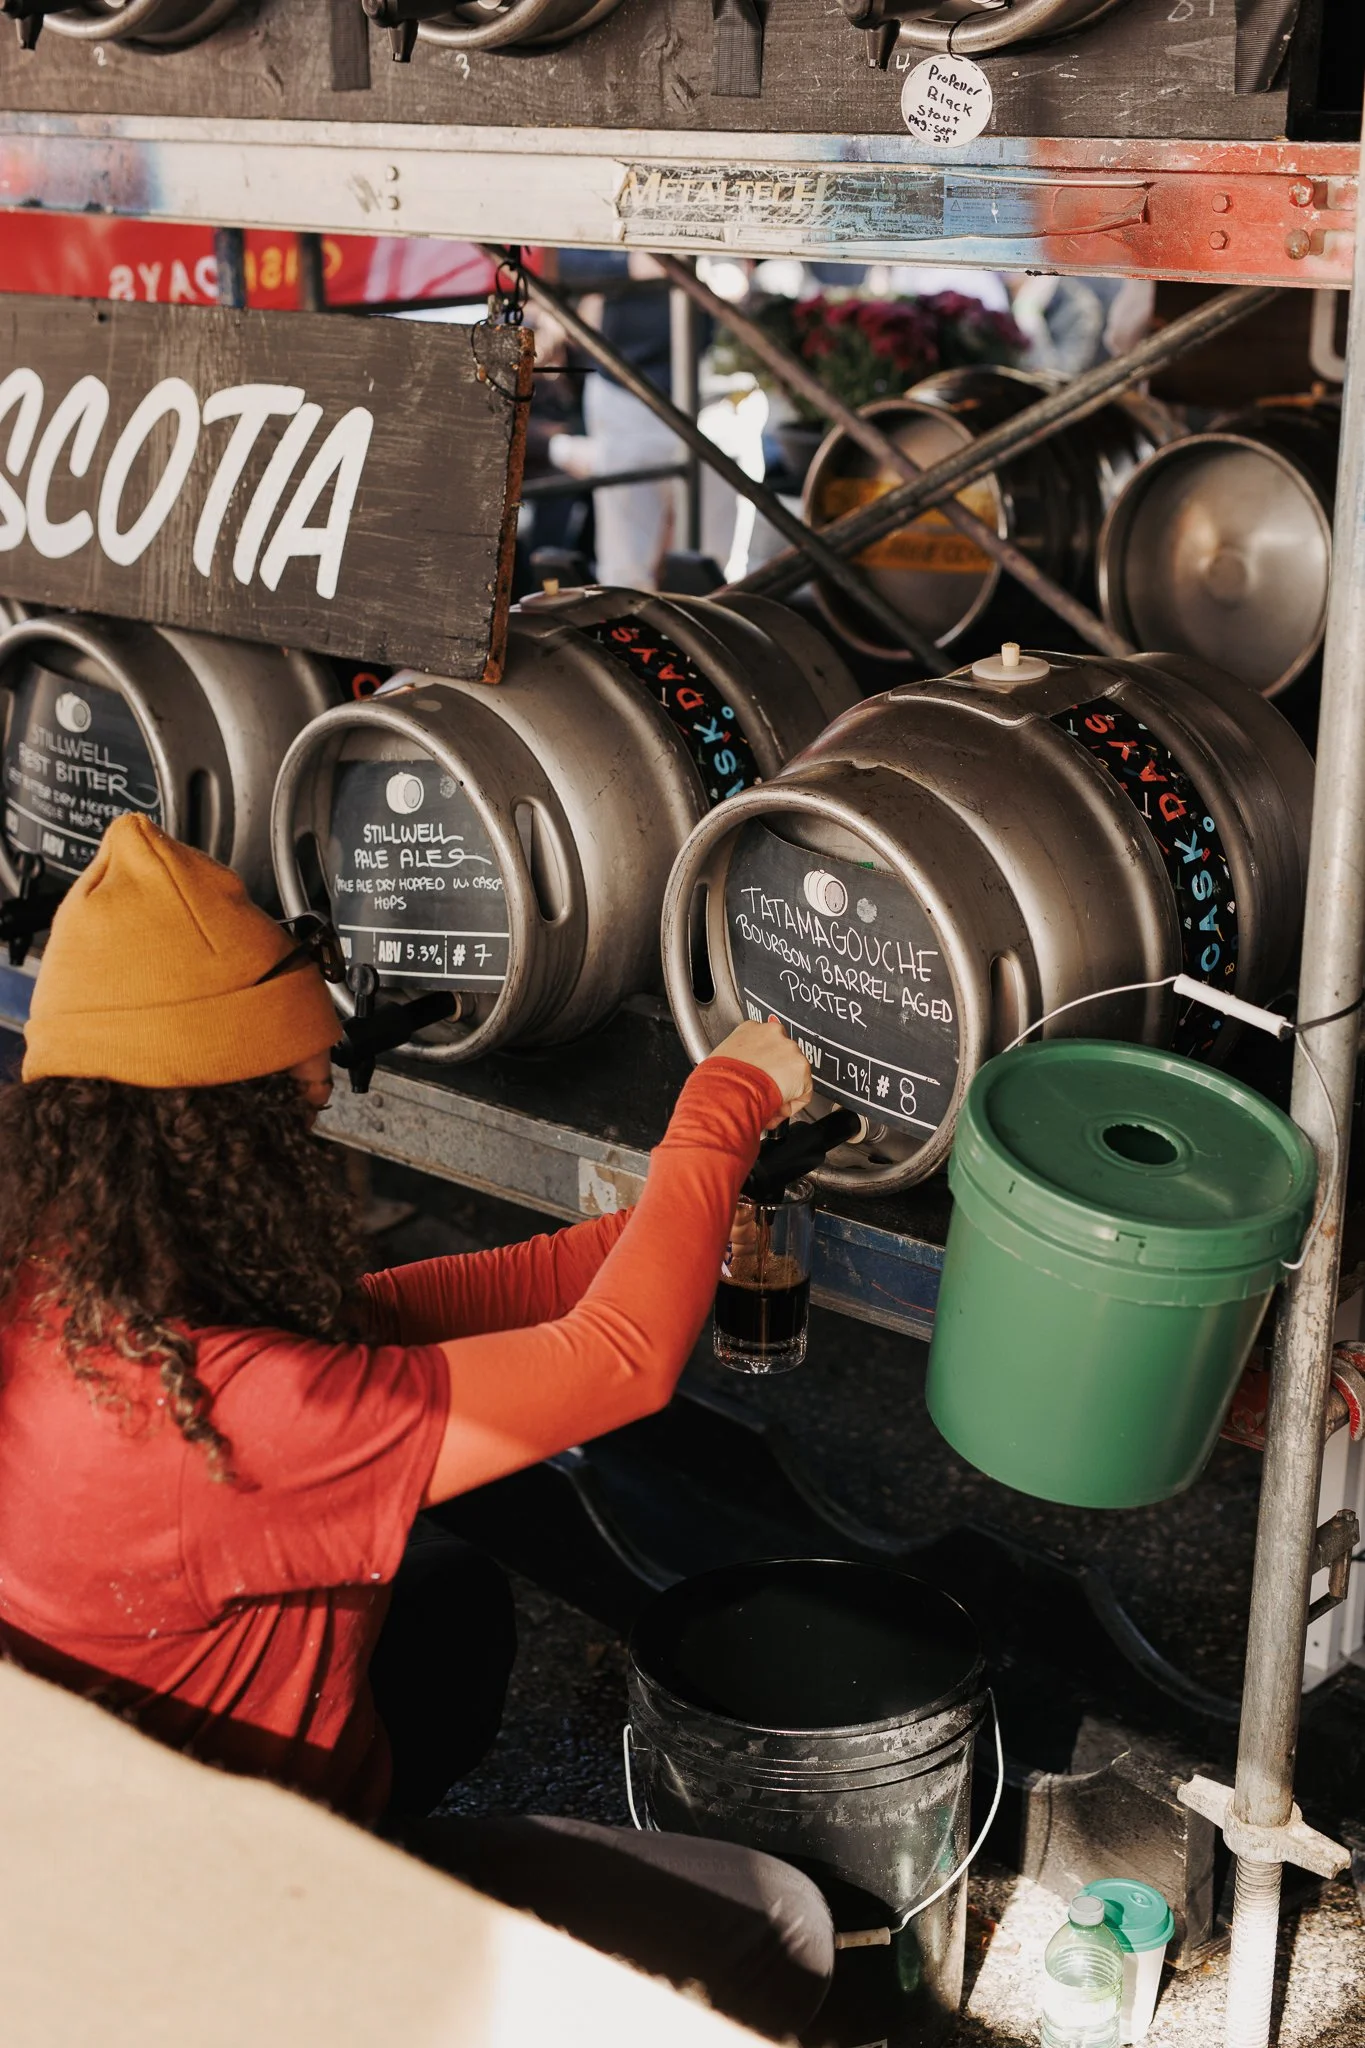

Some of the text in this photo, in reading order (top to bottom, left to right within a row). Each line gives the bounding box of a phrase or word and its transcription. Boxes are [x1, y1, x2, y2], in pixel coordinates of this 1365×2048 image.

[93, 46, 108, 67] 2
[455, 53, 471, 80] 3
[895, 52, 911, 73] 4
[31, 722, 128, 773] STILLWELL
[55, 759, 150, 809] BITTER
[363, 822, 464, 845] STILLWELL
[354, 848, 476, 870] PALE ALE
[376, 878, 397, 892] DRY
[399, 877, 446, 891] HOPPED
[374, 895, 407, 911] HOPS
[1174, 829, 1221, 973] CASK
[740, 886, 938, 982] TATAMAGOUCHE
[378, 940, 402, 963] ABV
[406, 943, 443, 966] 5.3%
[452, 944, 467, 966] #
[474, 943, 493, 967] 7
[736, 913, 953, 1023] BOURBON BARREL AGED
[779, 969, 868, 1028] PORTER
[825, 1052, 871, 1093] 7.9%
[876, 1075, 890, 1098] #
[899, 1077, 918, 1116] 8
